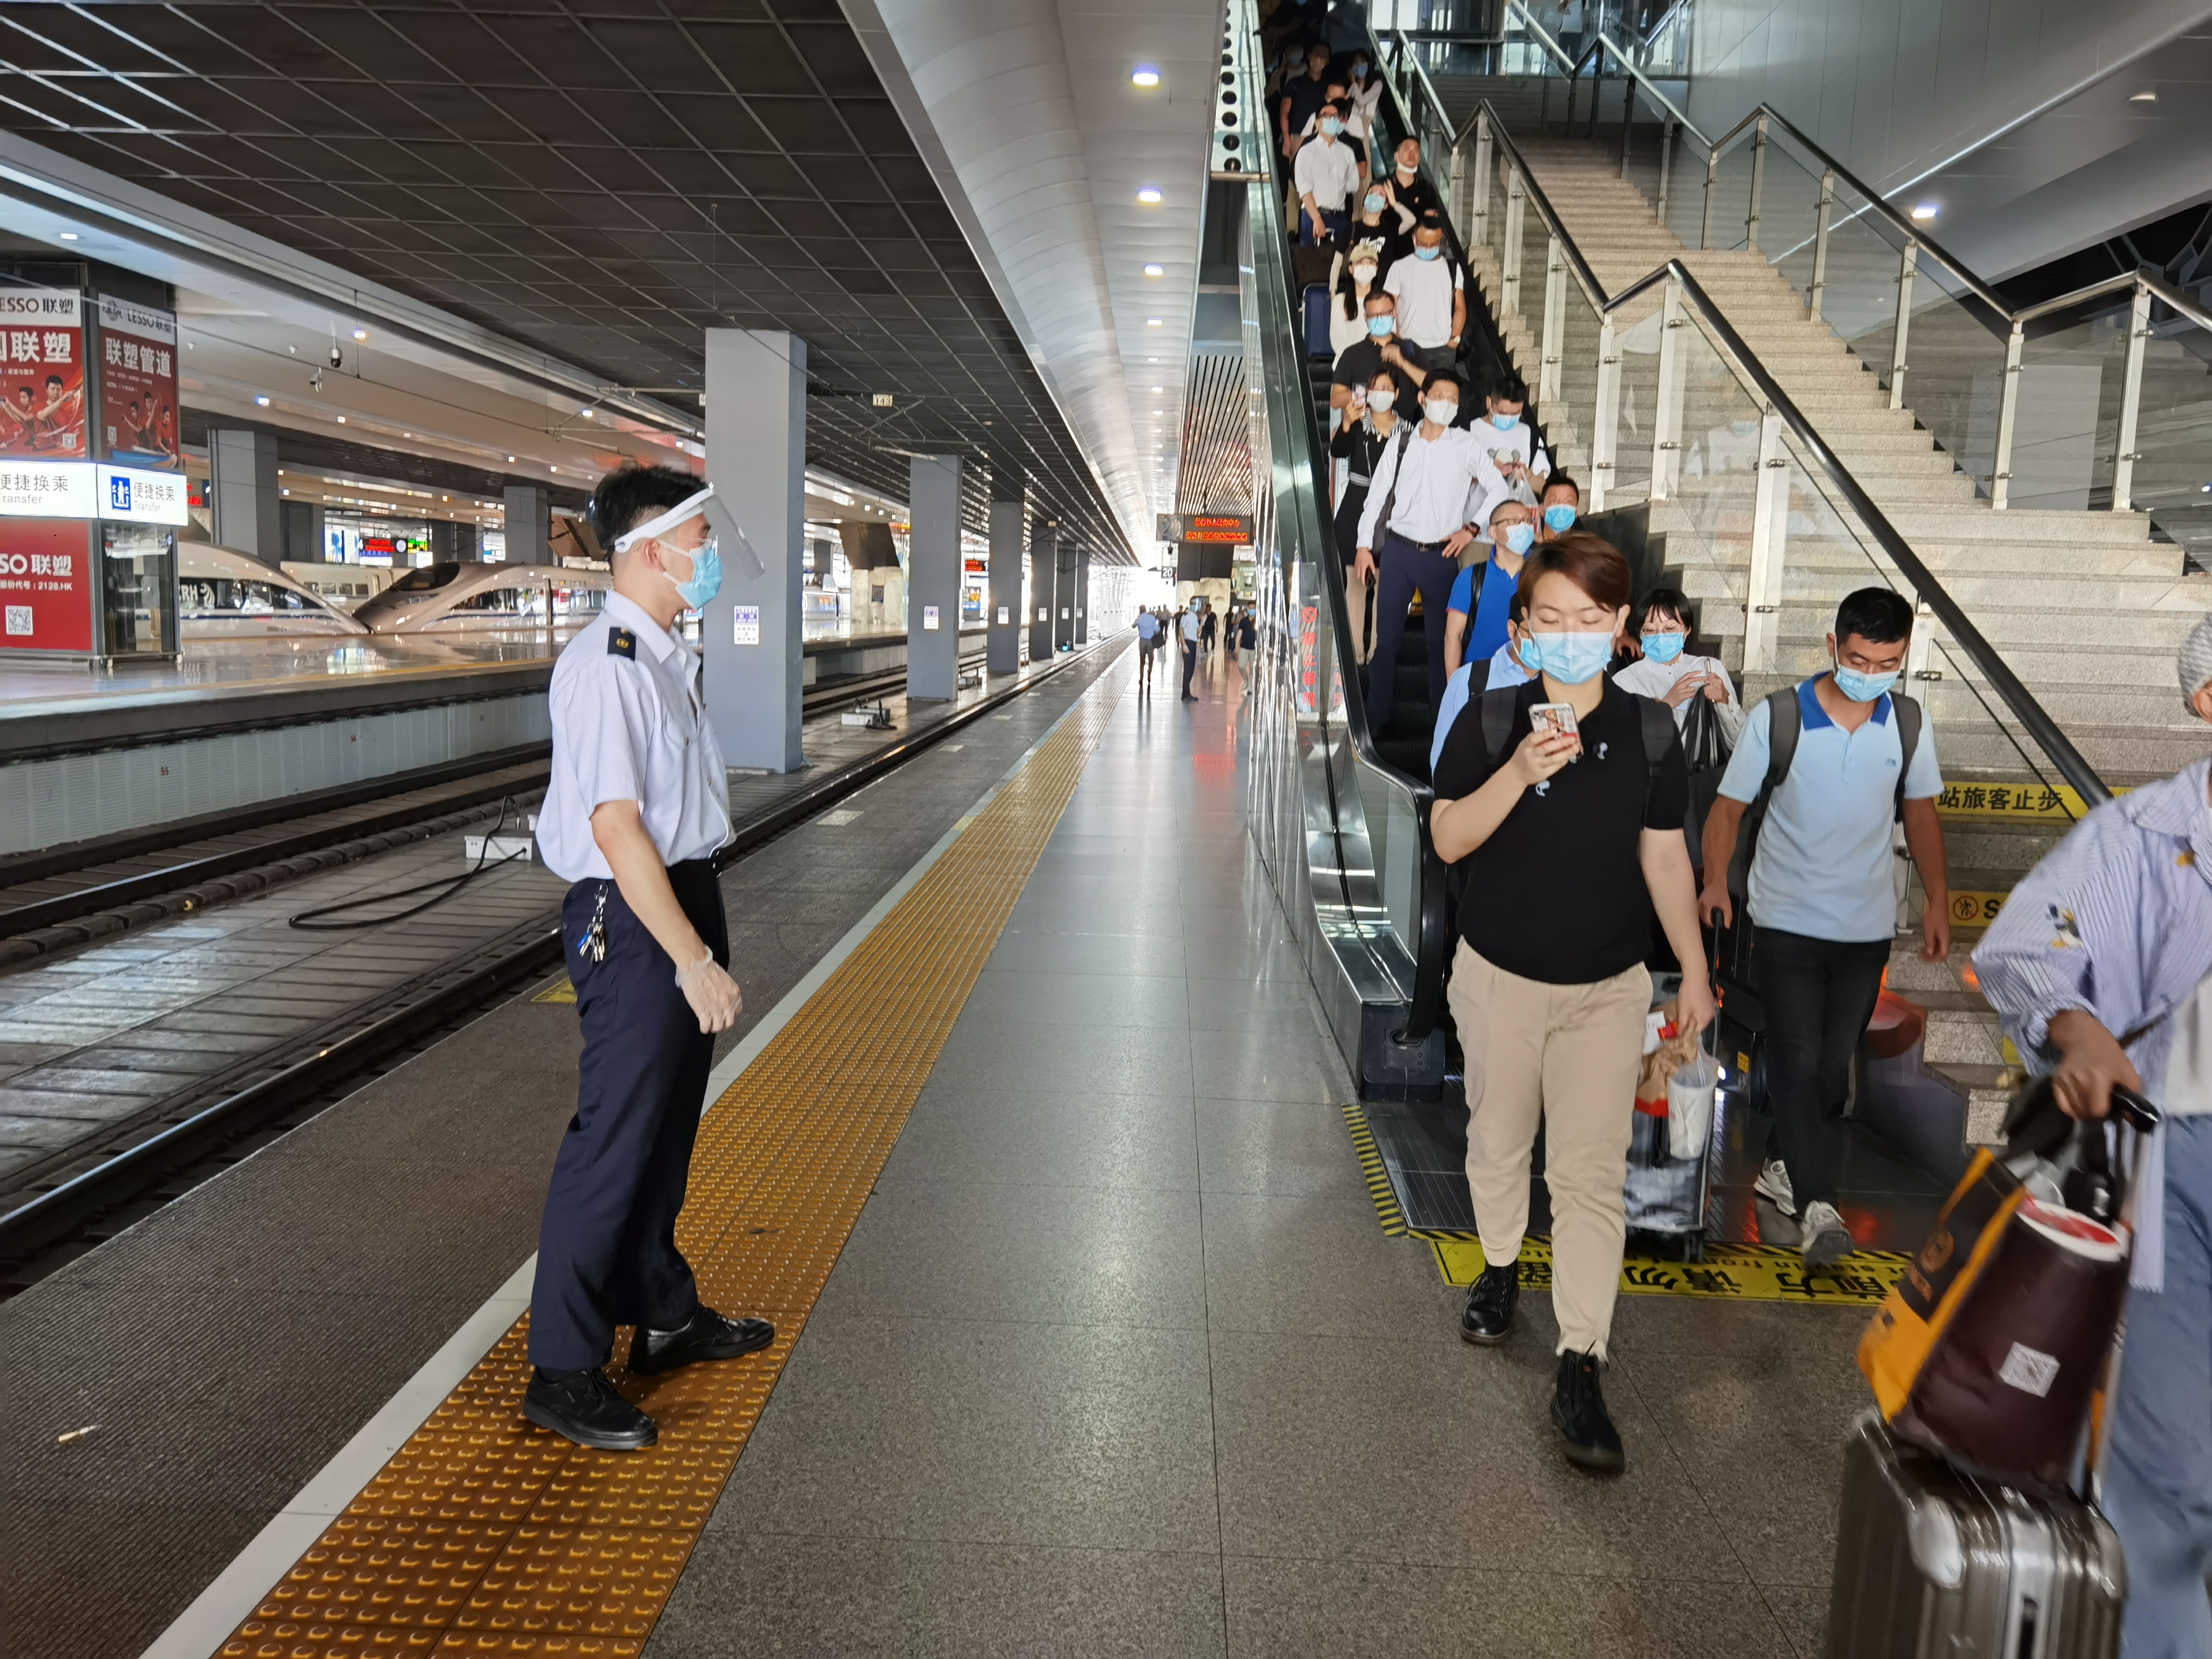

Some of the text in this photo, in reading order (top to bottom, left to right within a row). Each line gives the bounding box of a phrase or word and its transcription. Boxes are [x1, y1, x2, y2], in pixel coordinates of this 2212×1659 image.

[42, 298, 74, 315] 联塑
[105, 337, 172, 379] 联塑管道
[0, 493, 43, 504] ransfer
[133, 481, 175, 502] 便捷换乘
[134, 500, 161, 512] Transfer
[31, 554, 73, 577] 联塑
[1162, 567, 1173, 577] 20
[1938, 786, 2063, 812] 站旅客止步
